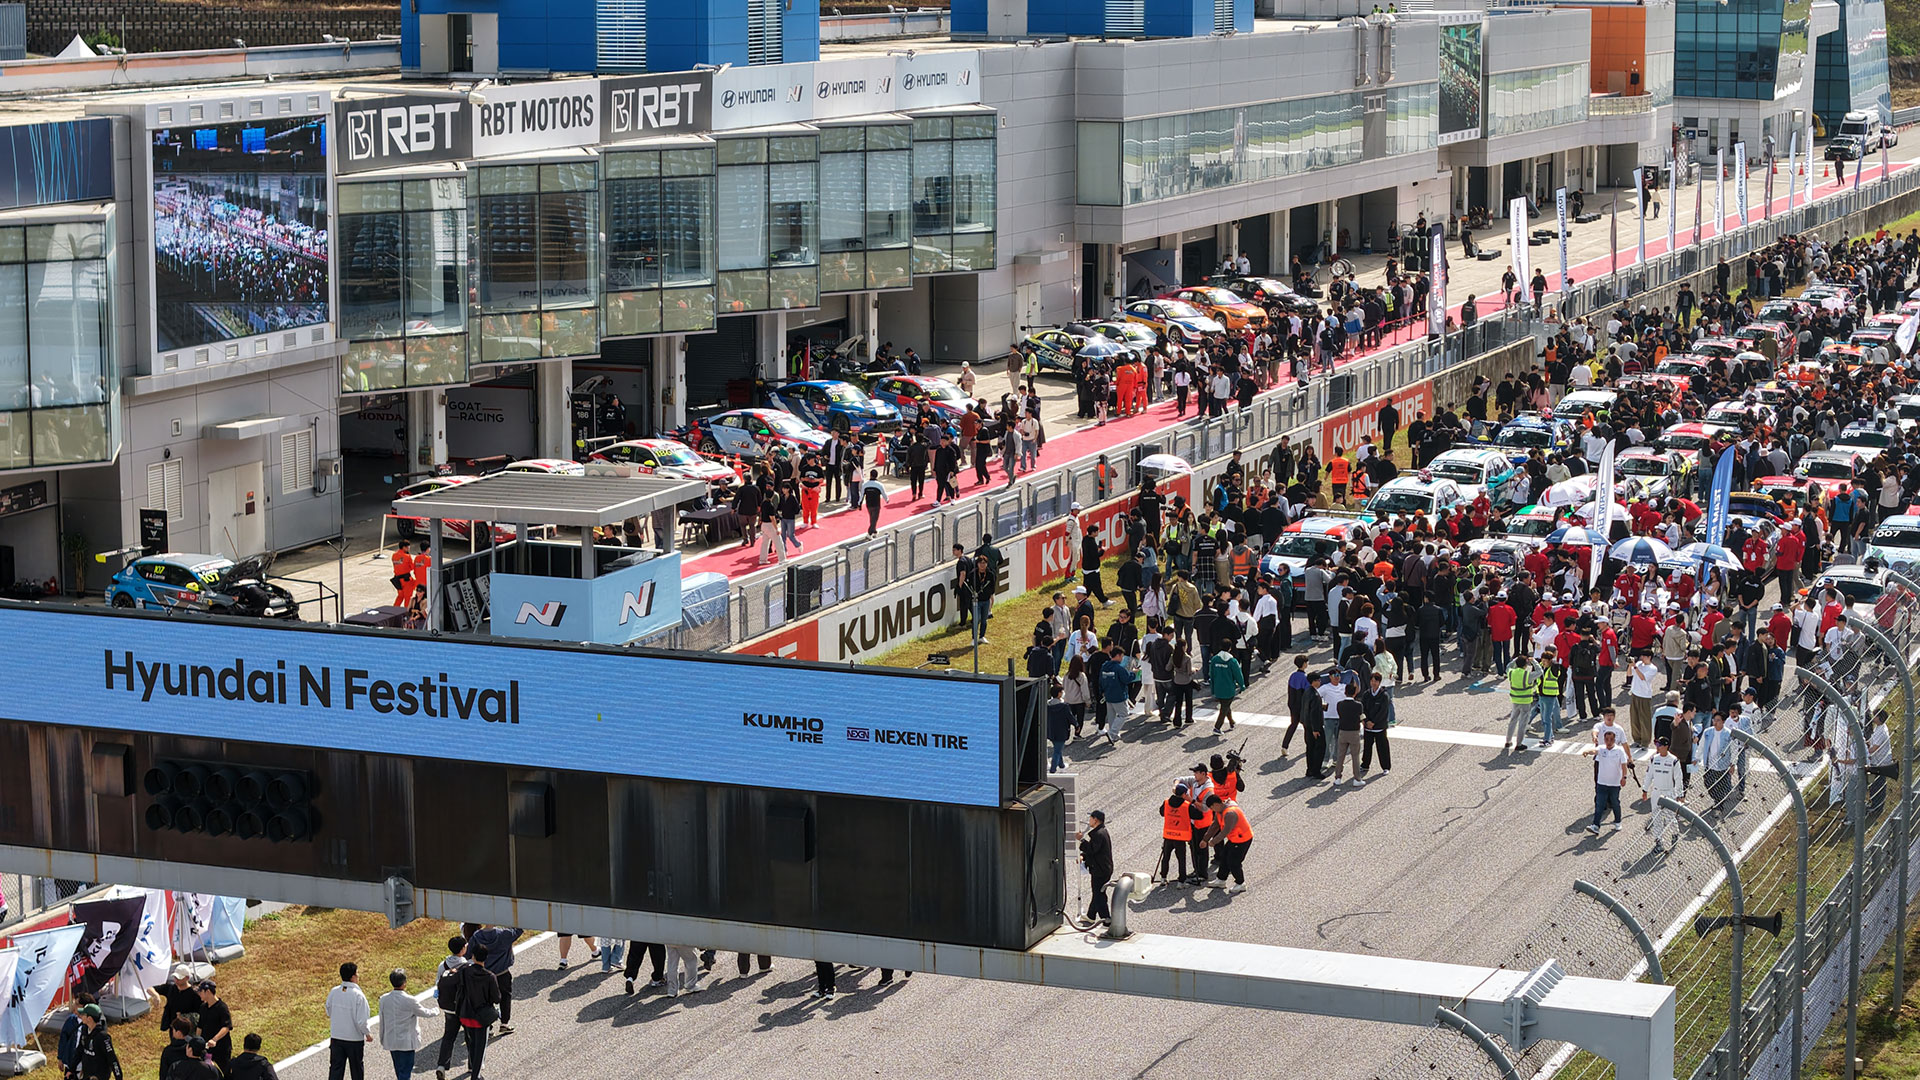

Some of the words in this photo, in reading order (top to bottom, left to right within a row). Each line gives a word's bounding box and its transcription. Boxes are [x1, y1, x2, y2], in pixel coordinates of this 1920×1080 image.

[832, 79, 866, 97] HYUNDAI
[916, 72, 948, 87] HYUNDAI
[738, 88, 776, 105] HYUNDAI
[637, 83, 701, 130] RBT
[480, 101, 516, 137] RBT
[521, 94, 594, 132] MOTORS
[381, 102, 461, 156] RBT
[449, 402, 481, 411] GOAT
[358, 412, 404, 421] HONDA
[459, 412, 505, 422] RACING
[1333, 410, 1383, 448] KUMH
[1499, 430, 1515, 438] 06
[1377, 492, 1390, 501] 19
[1510, 518, 1527, 527] 02
[154, 565, 165, 574] 107
[200, 572, 220, 584] 107
[463, 586, 476, 622] ENGINE
[839, 582, 946, 660] KUMHO
[105, 649, 286, 704] Hyundai
[300, 664, 331, 708] N
[344, 668, 520, 724] Festival
[743, 712, 824, 732] KUMHO
[786, 731, 824, 744] TIRE
[875, 729, 928, 747] NEXEN
[932, 733, 969, 750] TIRE
